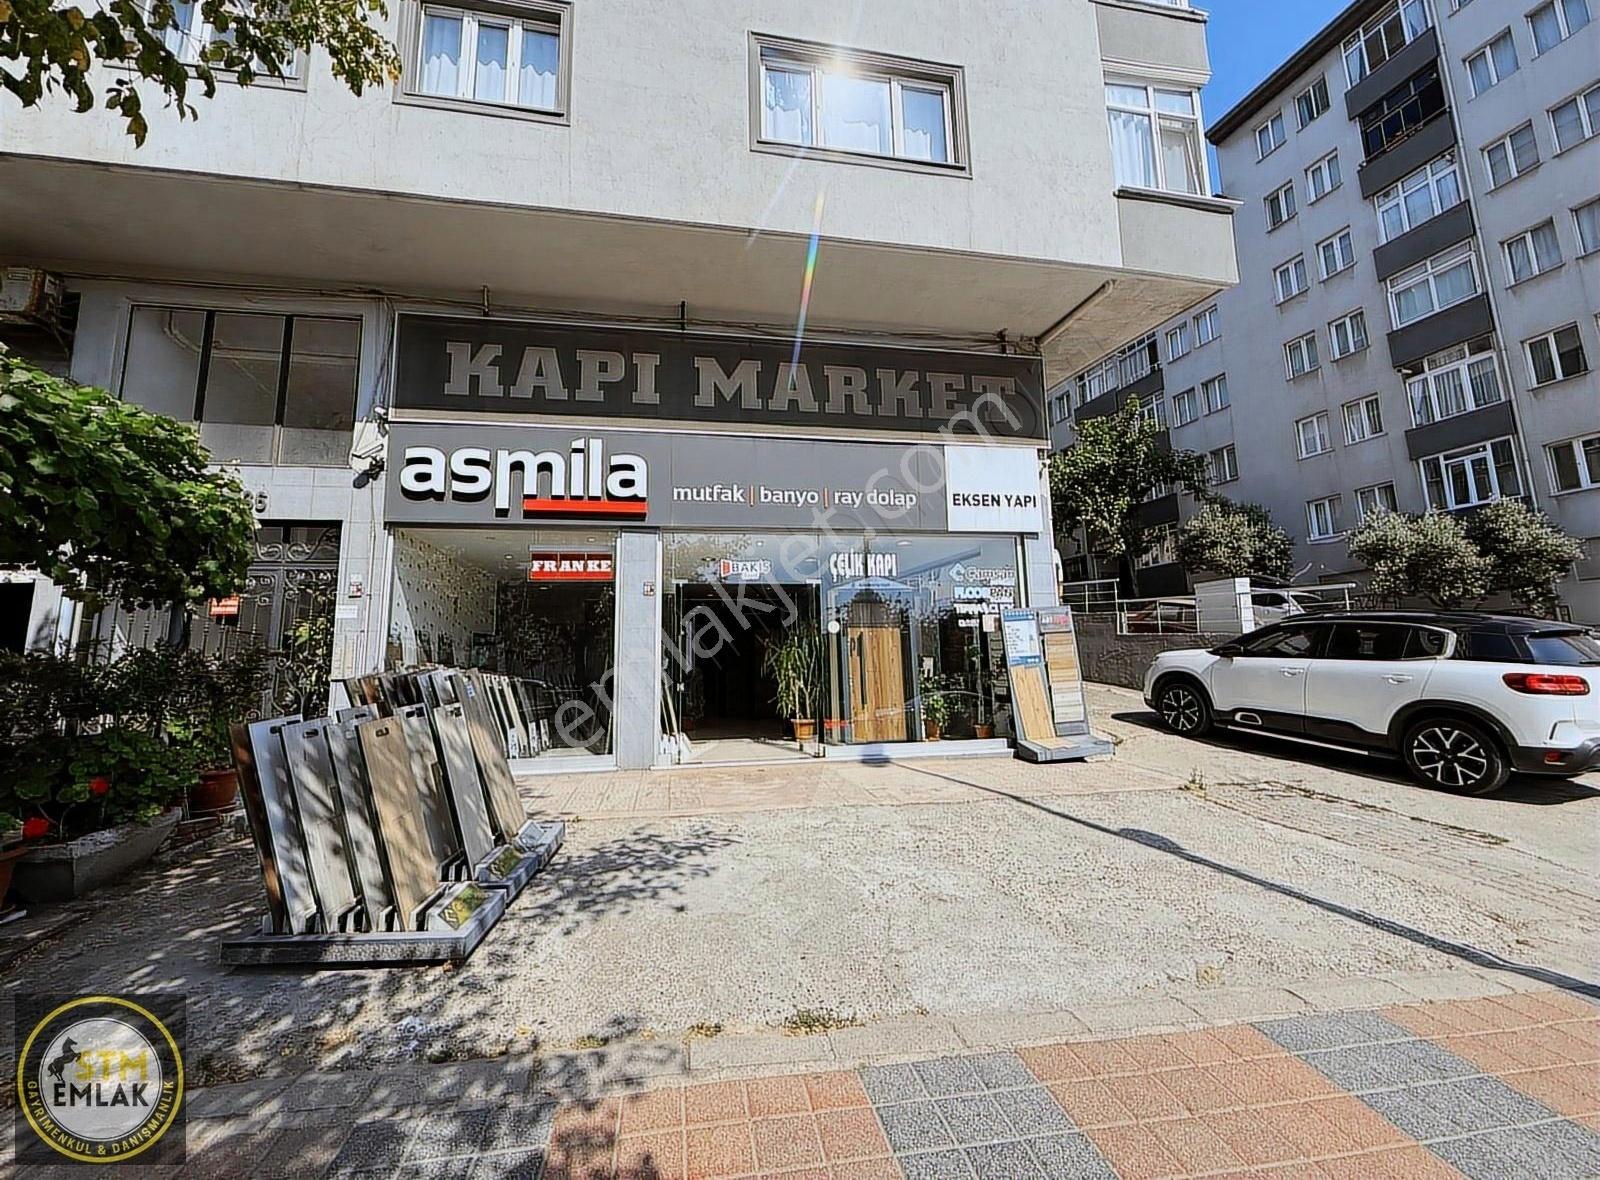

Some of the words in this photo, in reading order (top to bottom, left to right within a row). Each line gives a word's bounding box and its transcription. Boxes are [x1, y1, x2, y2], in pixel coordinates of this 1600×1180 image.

[444, 341, 661, 405] KAPI
[694, 356, 1016, 423] MARKET
[400, 437, 648, 518] asmila
[673, 485, 745, 502] mutfak
[759, 486, 819, 507] banyo
[834, 490, 863, 508] ray
[866, 489, 917, 508] dolap
[952, 493, 1001, 507] EKSEN
[1004, 494, 1037, 508] YAPI
[531, 560, 612, 572] FRANKE
[867, 553, 898, 577] KAPI
